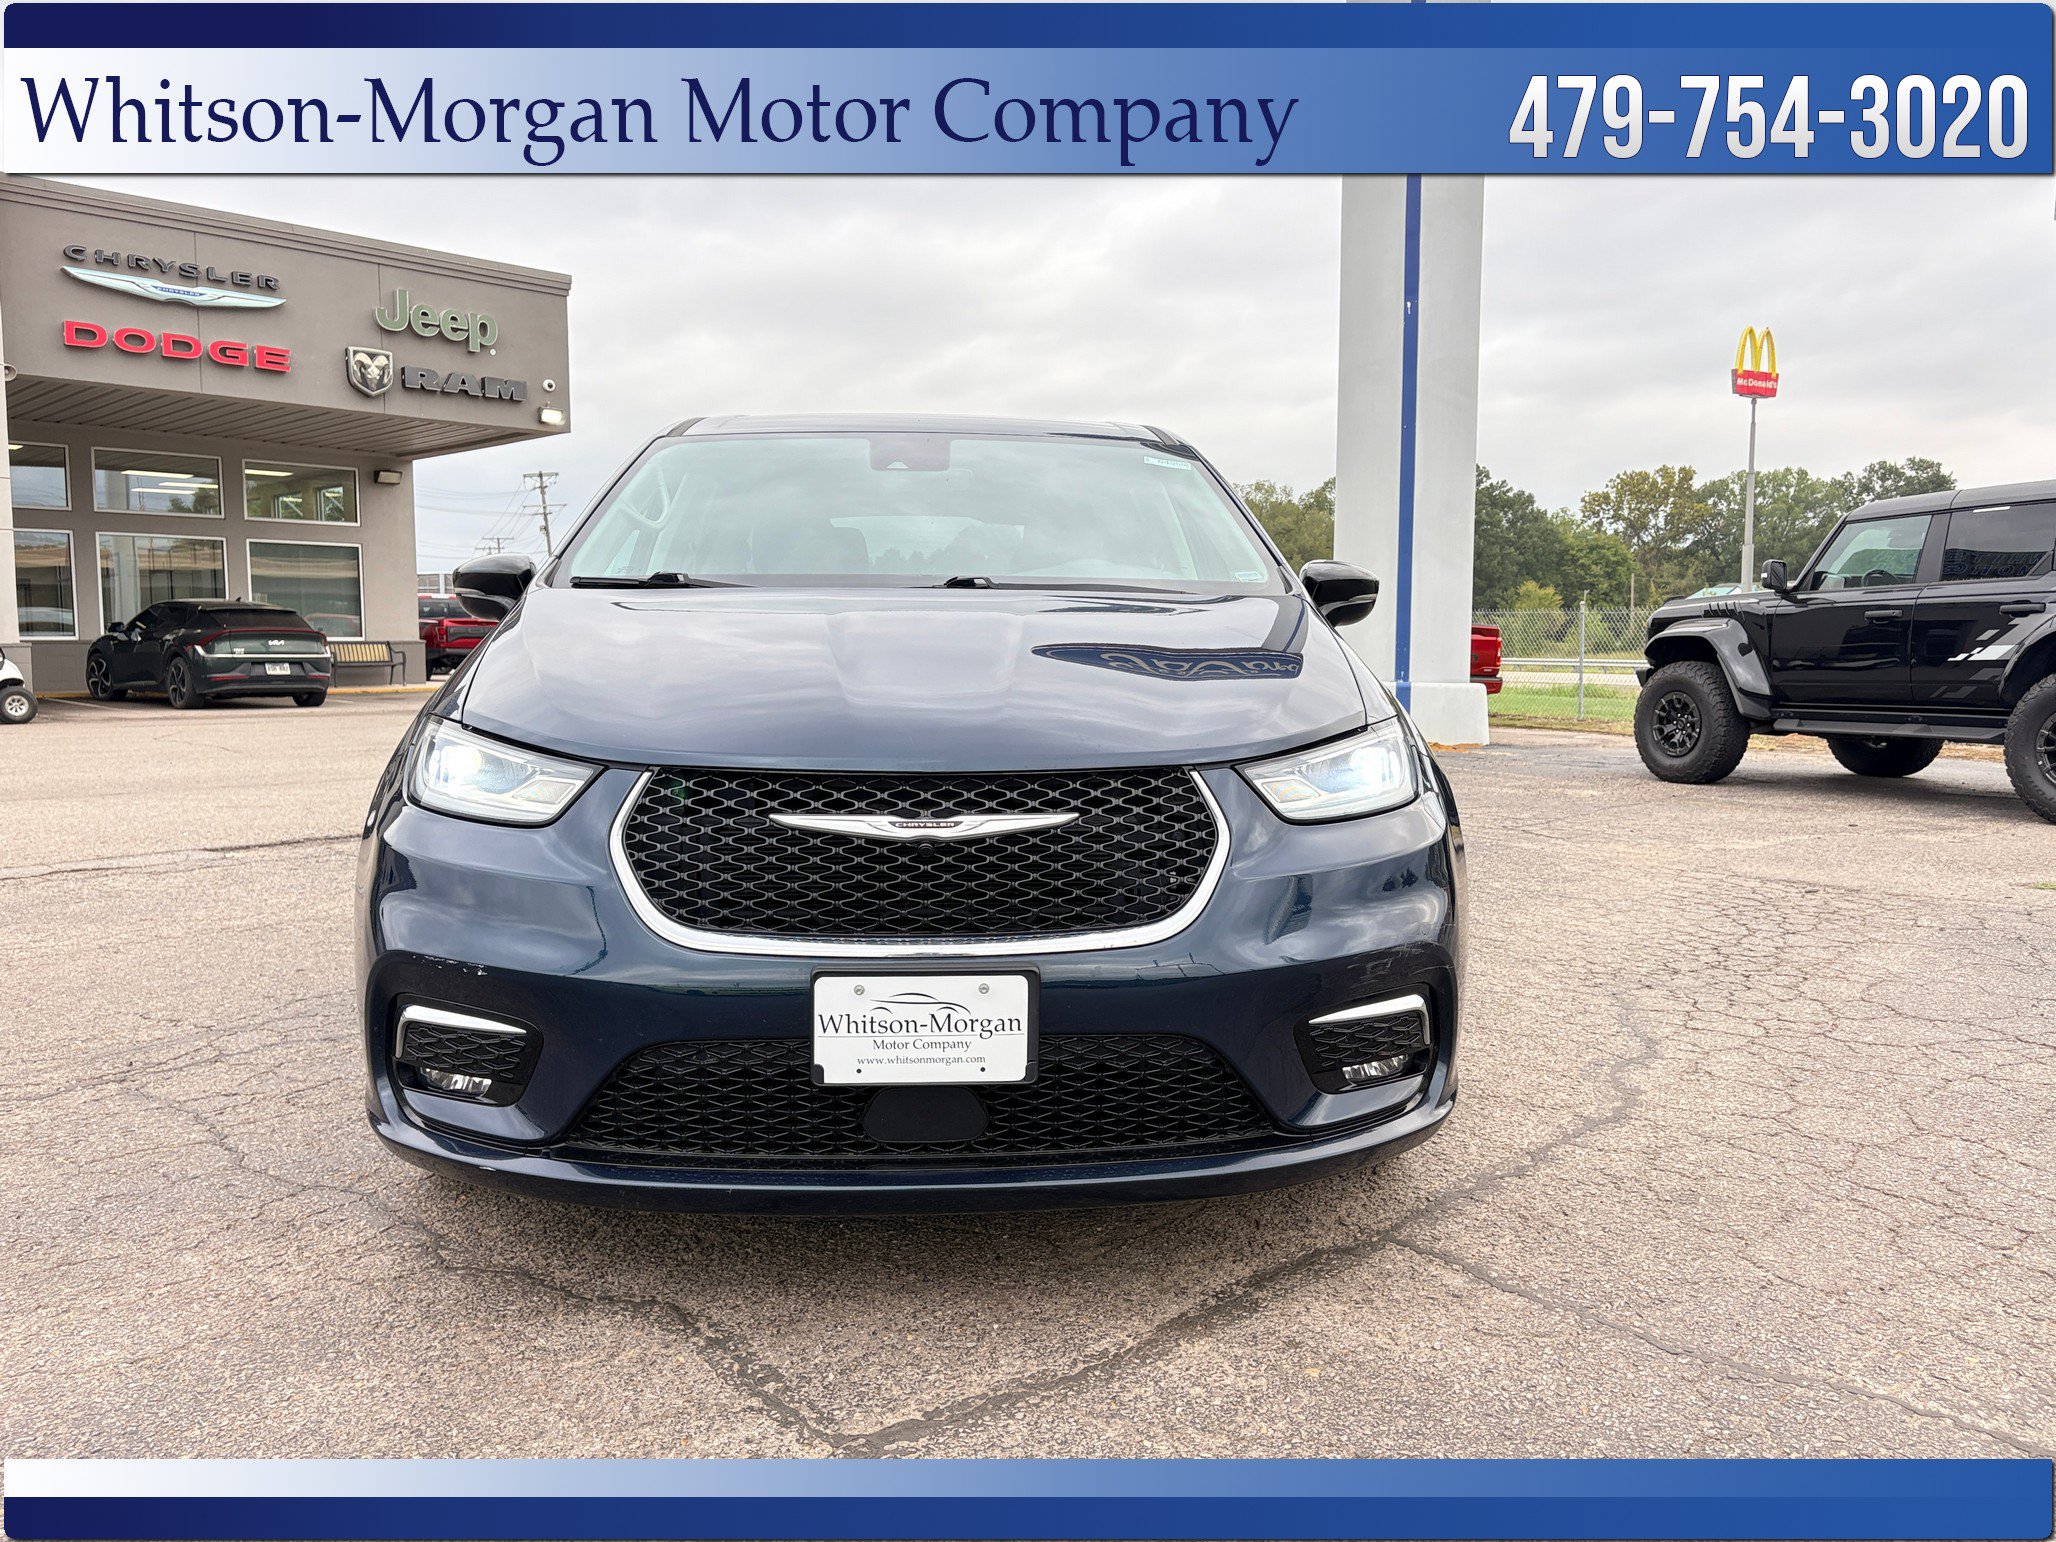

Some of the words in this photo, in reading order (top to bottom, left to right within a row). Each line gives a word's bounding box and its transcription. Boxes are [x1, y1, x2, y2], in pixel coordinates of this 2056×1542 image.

[63, 244, 281, 290] CHRYSLER
[375, 288, 499, 353] Jeep
[63, 320, 292, 373] DODGE
[401, 365, 528, 402] RAM
[1736, 377, 1777, 389] McDonald's
[818, 1012, 1022, 1039] Whitson-Morgan
[857, 1055, 986, 1067] www.whitsonmorgan.com
[873, 1039, 910, 1051] Motor
[913, 1038, 972, 1053] Company
